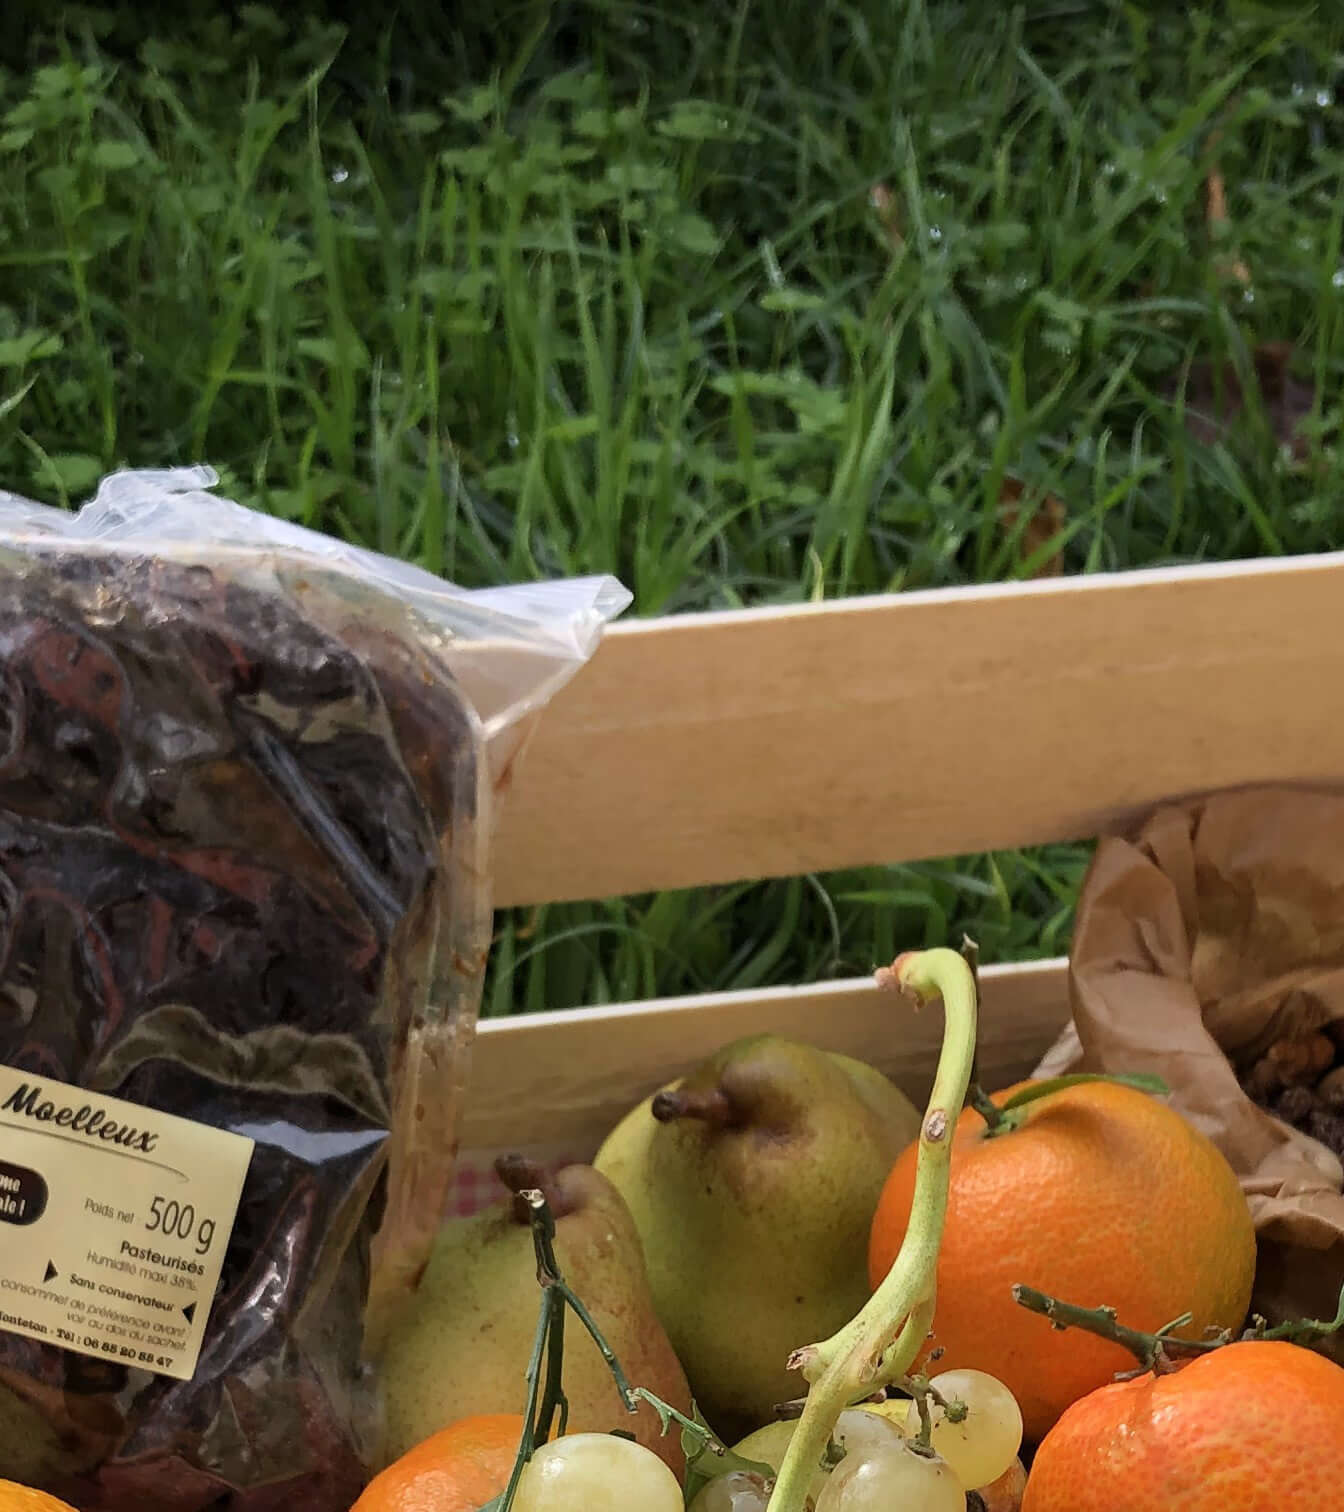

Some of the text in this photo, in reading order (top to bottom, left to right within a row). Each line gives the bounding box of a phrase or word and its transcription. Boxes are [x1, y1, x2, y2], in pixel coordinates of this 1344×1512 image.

[1, 1083, 159, 1154] Moelleux
[84, 1196, 216, 1255] Poids net 500 g
[120, 1240, 205, 1276] Pasteurisés
[70, 1273, 175, 1312] Sans conservateur
